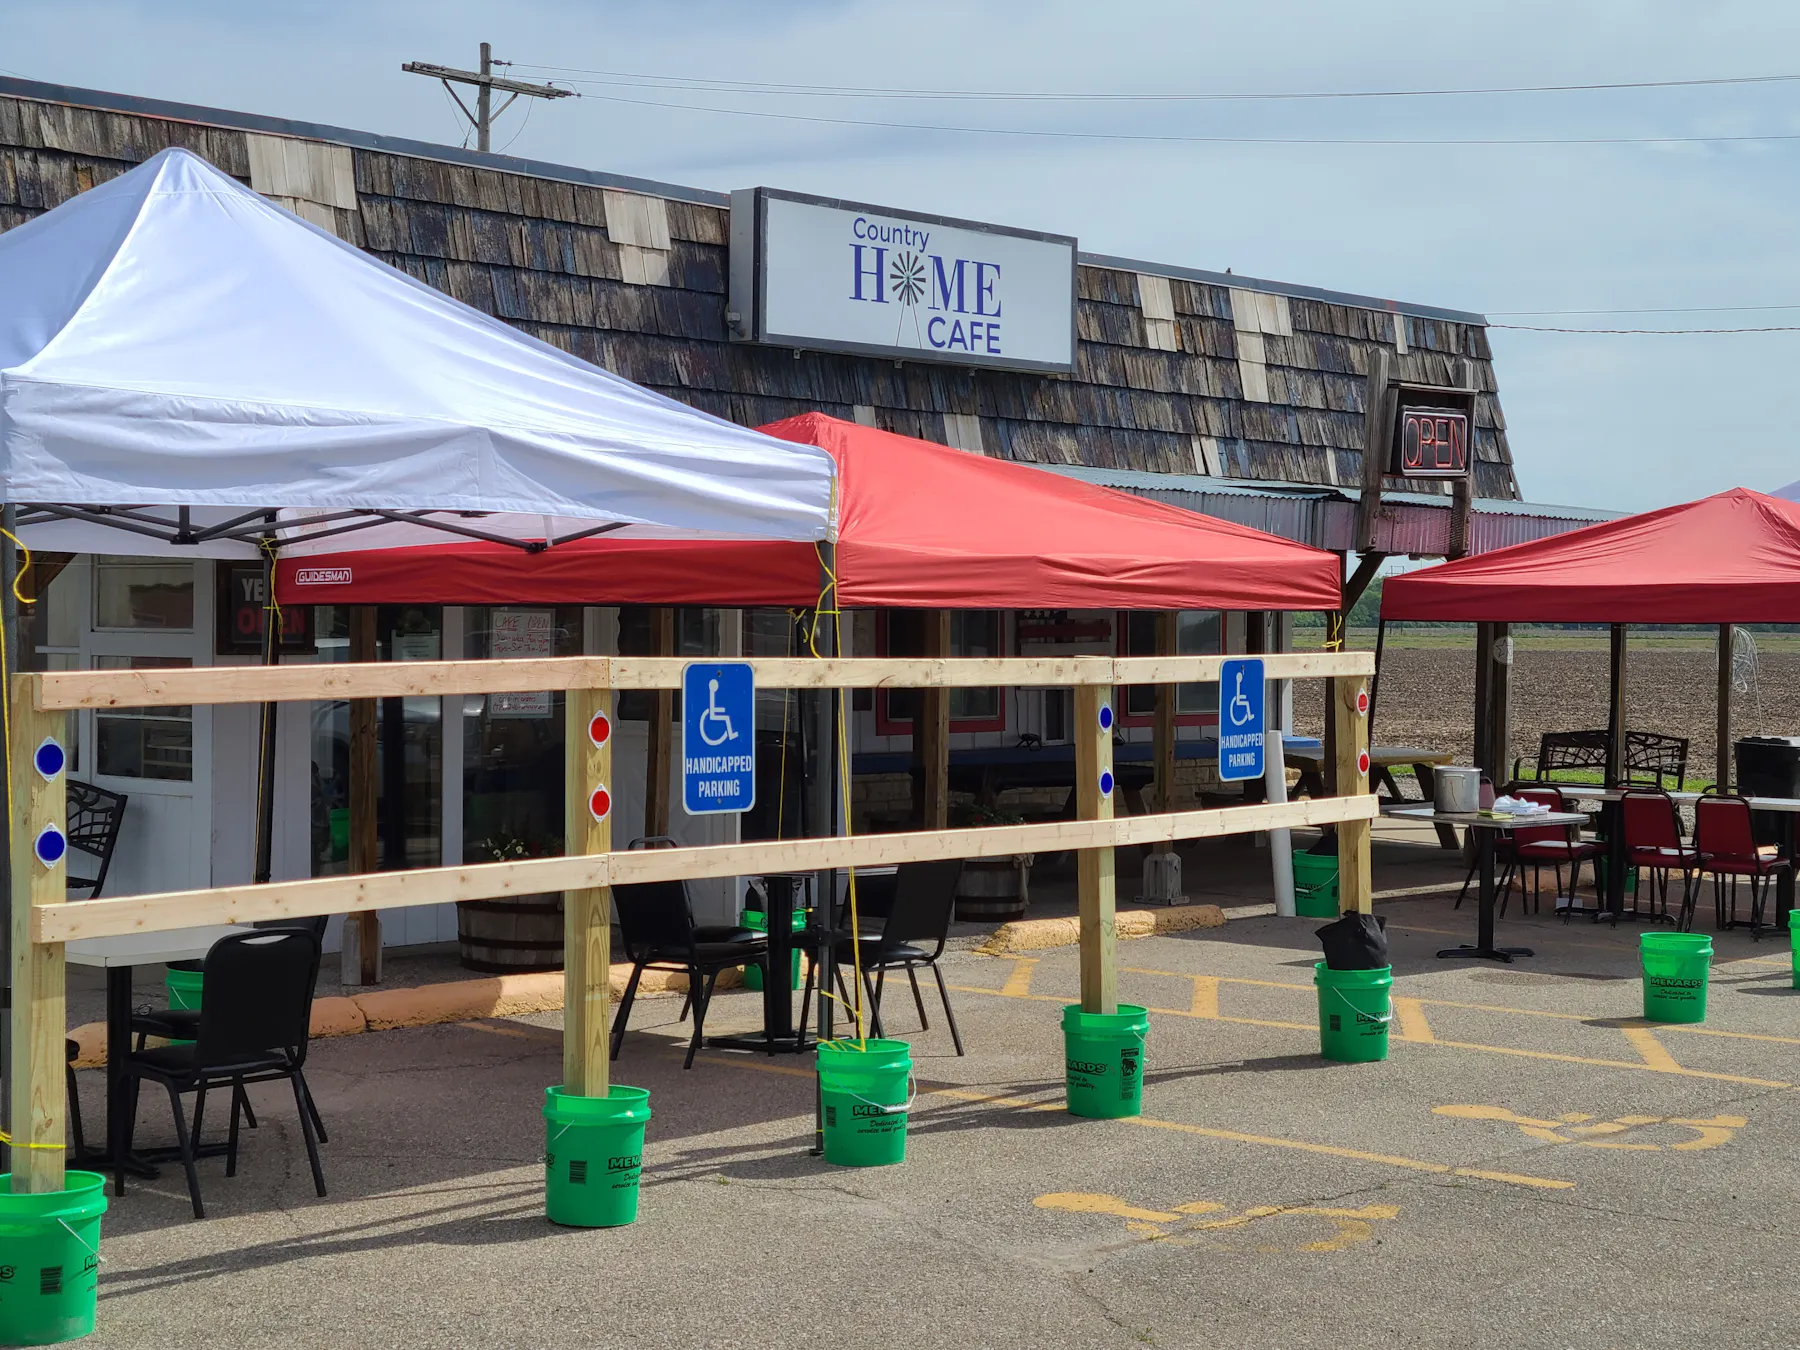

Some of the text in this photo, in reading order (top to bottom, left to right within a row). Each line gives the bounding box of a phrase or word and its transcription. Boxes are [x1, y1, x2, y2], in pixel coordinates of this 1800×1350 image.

[853, 217, 930, 253] Country
[927, 316, 1002, 354] CAFE
[1405, 418, 1464, 468] OPEN
[298, 570, 350, 582] GUIDESMAN
[1221, 733, 1262, 749] HANDICAPPED
[685, 755, 752, 775] HANDICAPPED
[1228, 752, 1256, 768] PARKING
[698, 779, 740, 798] PARKING
[1650, 977, 1704, 988] MENARDS
